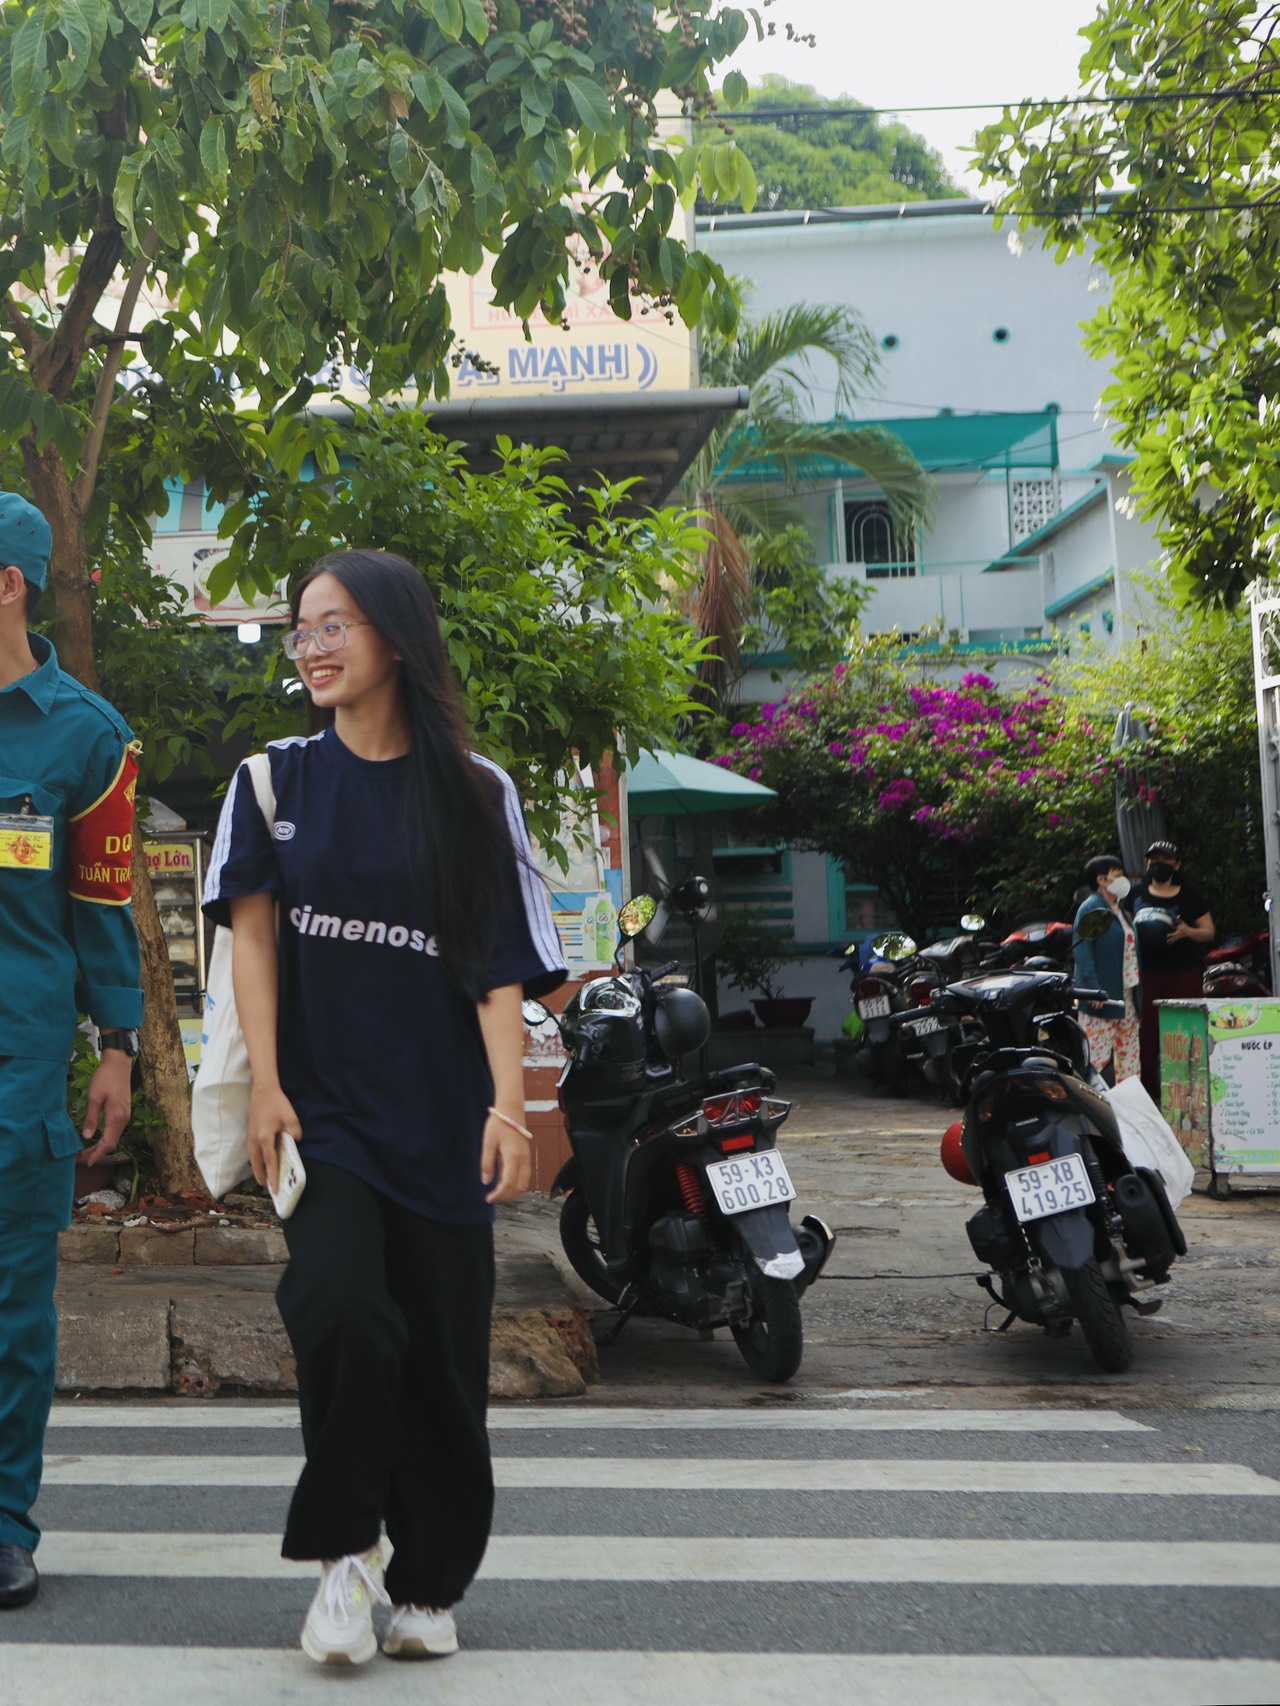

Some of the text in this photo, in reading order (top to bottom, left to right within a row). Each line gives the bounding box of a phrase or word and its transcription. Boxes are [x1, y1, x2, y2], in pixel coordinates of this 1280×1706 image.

[164, 849, 191, 867] Lớn
[1241, 1040, 1261, 1051] NƯỚC
[719, 1156, 775, 1186] 59-X3
[1017, 1160, 1074, 1193] 59-XB
[721, 1177, 790, 1210] 600.28
[1022, 1184, 1088, 1217] 419.25
